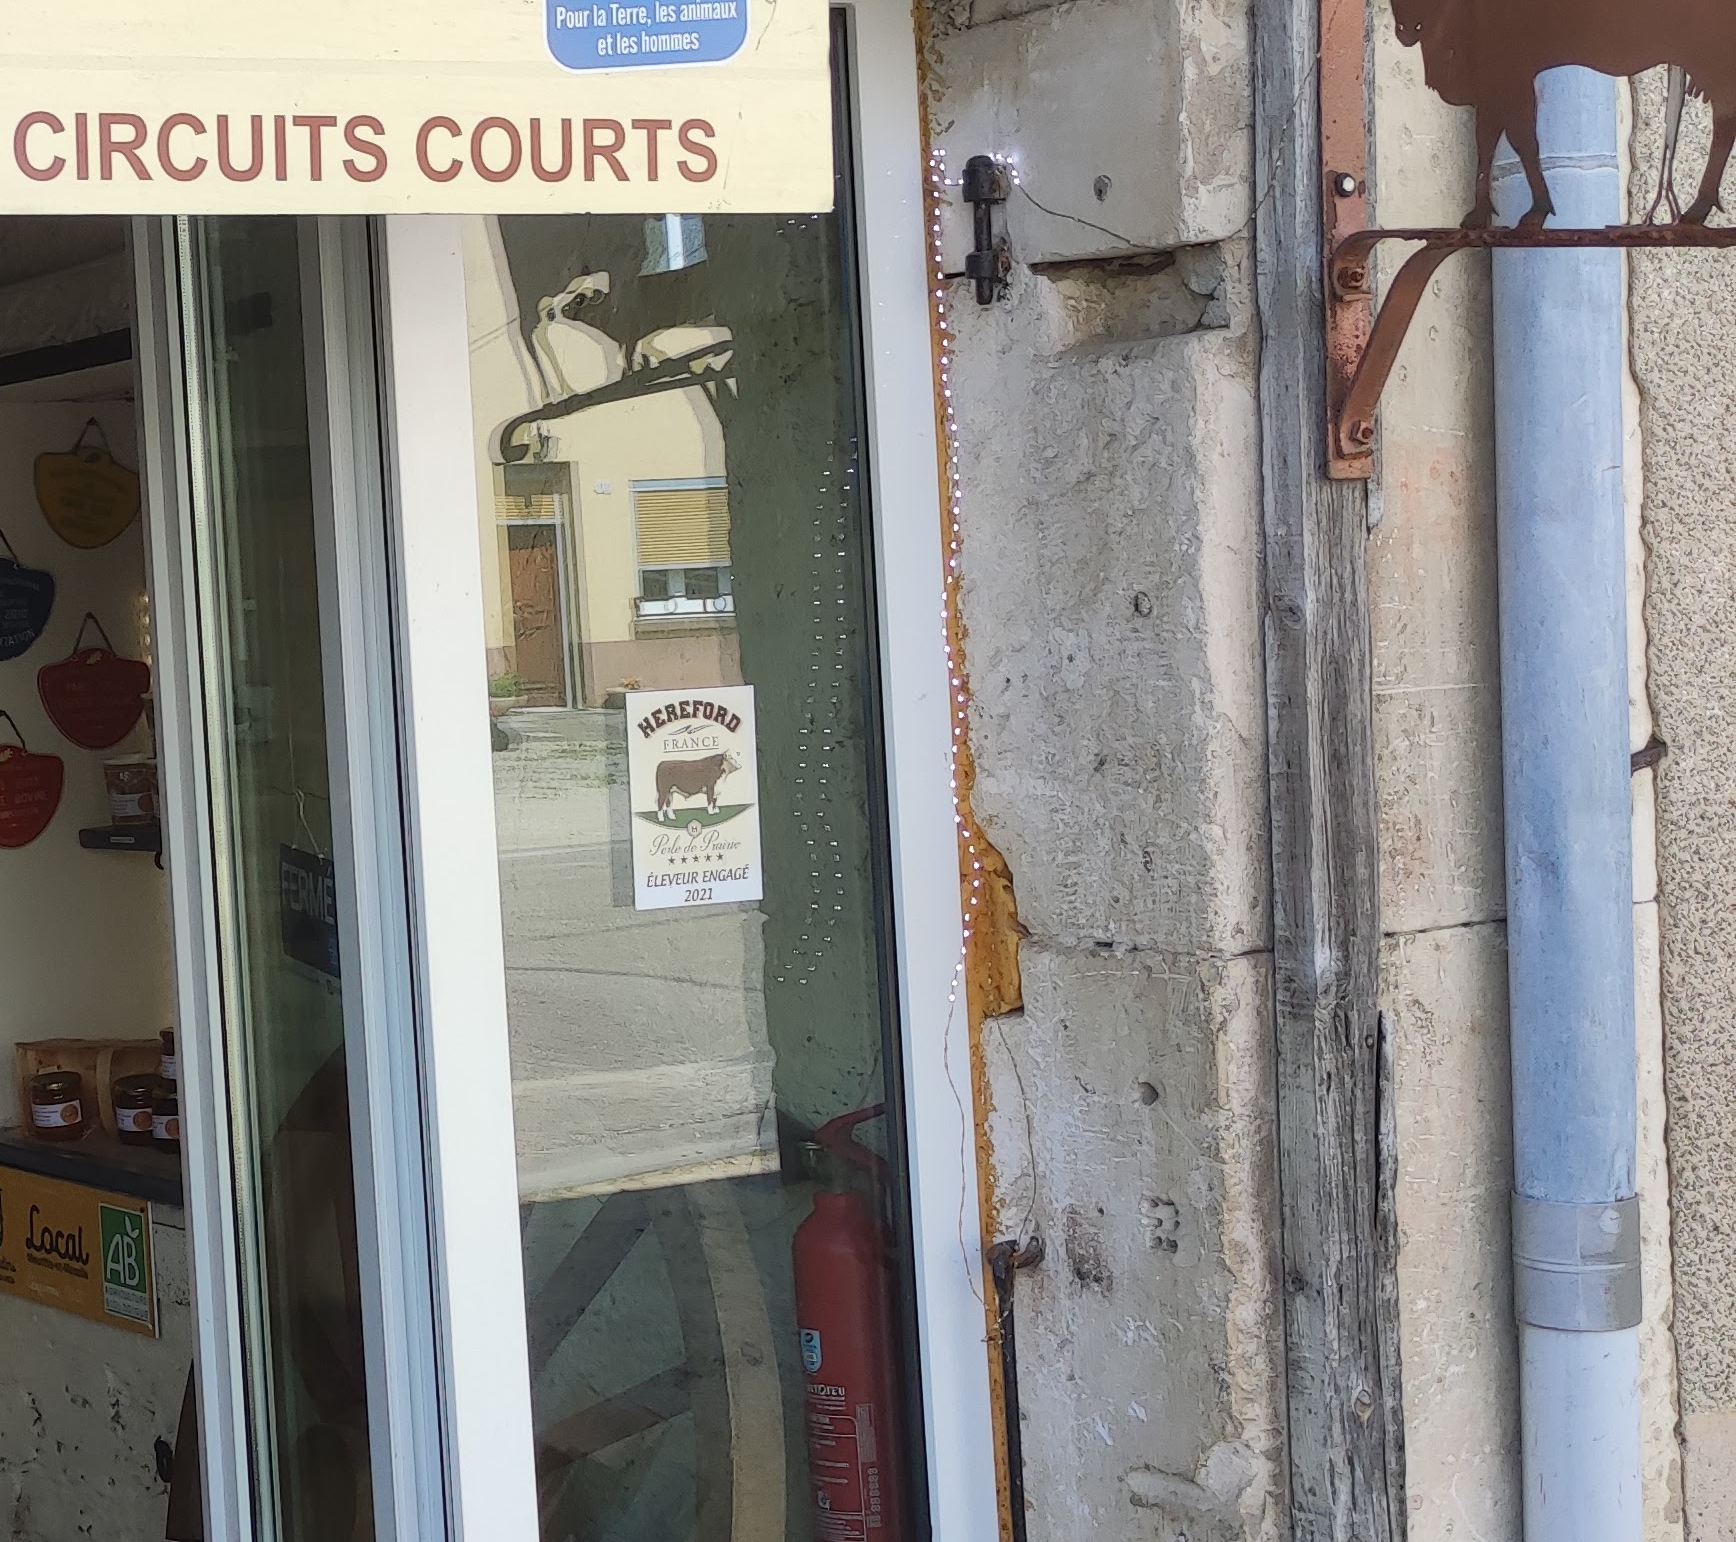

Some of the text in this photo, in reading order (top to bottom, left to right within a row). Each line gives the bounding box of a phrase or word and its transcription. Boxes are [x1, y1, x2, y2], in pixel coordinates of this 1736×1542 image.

[555, 5, 590, 30] Pour
[592, 6, 608, 28] la
[608, 2, 652, 27] Terre,
[654, 0, 677, 23] les
[596, 30, 700, 57] et les hommes
[12, 112, 389, 183] CIRCUITS
[415, 115, 720, 184] COURTS
[636, 699, 744, 740] HEREFORD
[663, 735, 720, 752] FRANCE
[649, 833, 681, 857] Perle
[682, 837, 698, 855] de
[646, 862, 751, 889] ÉLEVEUR ENGAGÉ
[683, 887, 715, 904] 2021
[25, 1204, 90, 1266] Local
[106, 1234, 141, 1288] AB
